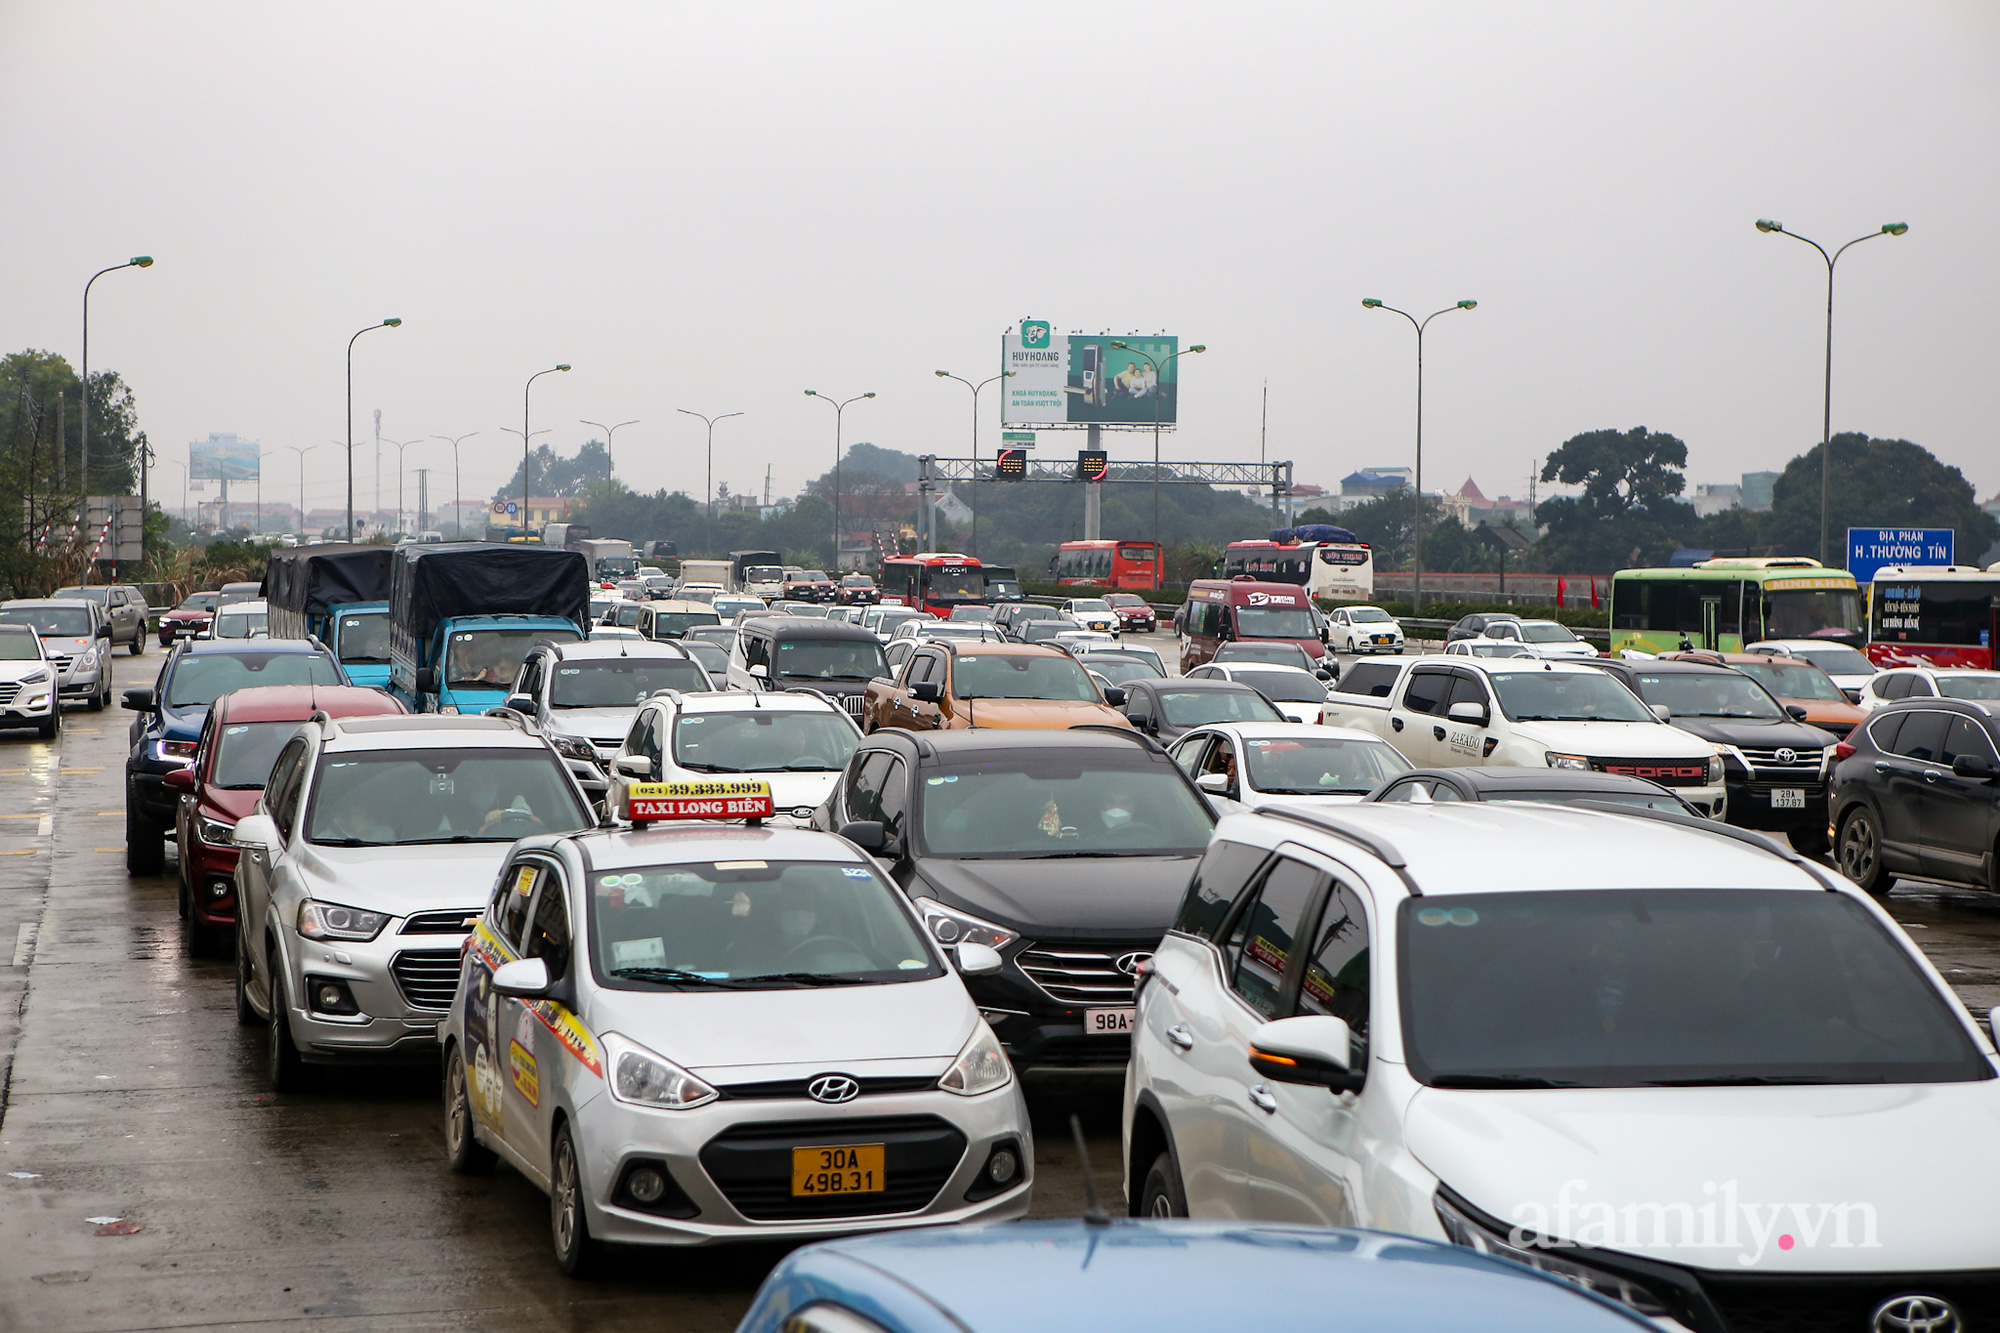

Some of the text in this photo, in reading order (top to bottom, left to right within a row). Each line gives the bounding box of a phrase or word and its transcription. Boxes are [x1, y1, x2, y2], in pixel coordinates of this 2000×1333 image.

[1012, 351, 1059, 361] HUYHOANG
[1879, 531, 1895, 543] ĐỊA
[1855, 541, 1947, 559] H.THƯỜNG TÍN
[1773, 578, 1852, 589] MINH KHAI
[1780, 790, 1795, 798] 28A
[634, 797, 766, 814] TAXI LONG BIÊN
[1776, 799, 1801, 807] 137.87
[820, 1148, 859, 1170] 30A
[803, 1170, 873, 1193] 498.31
